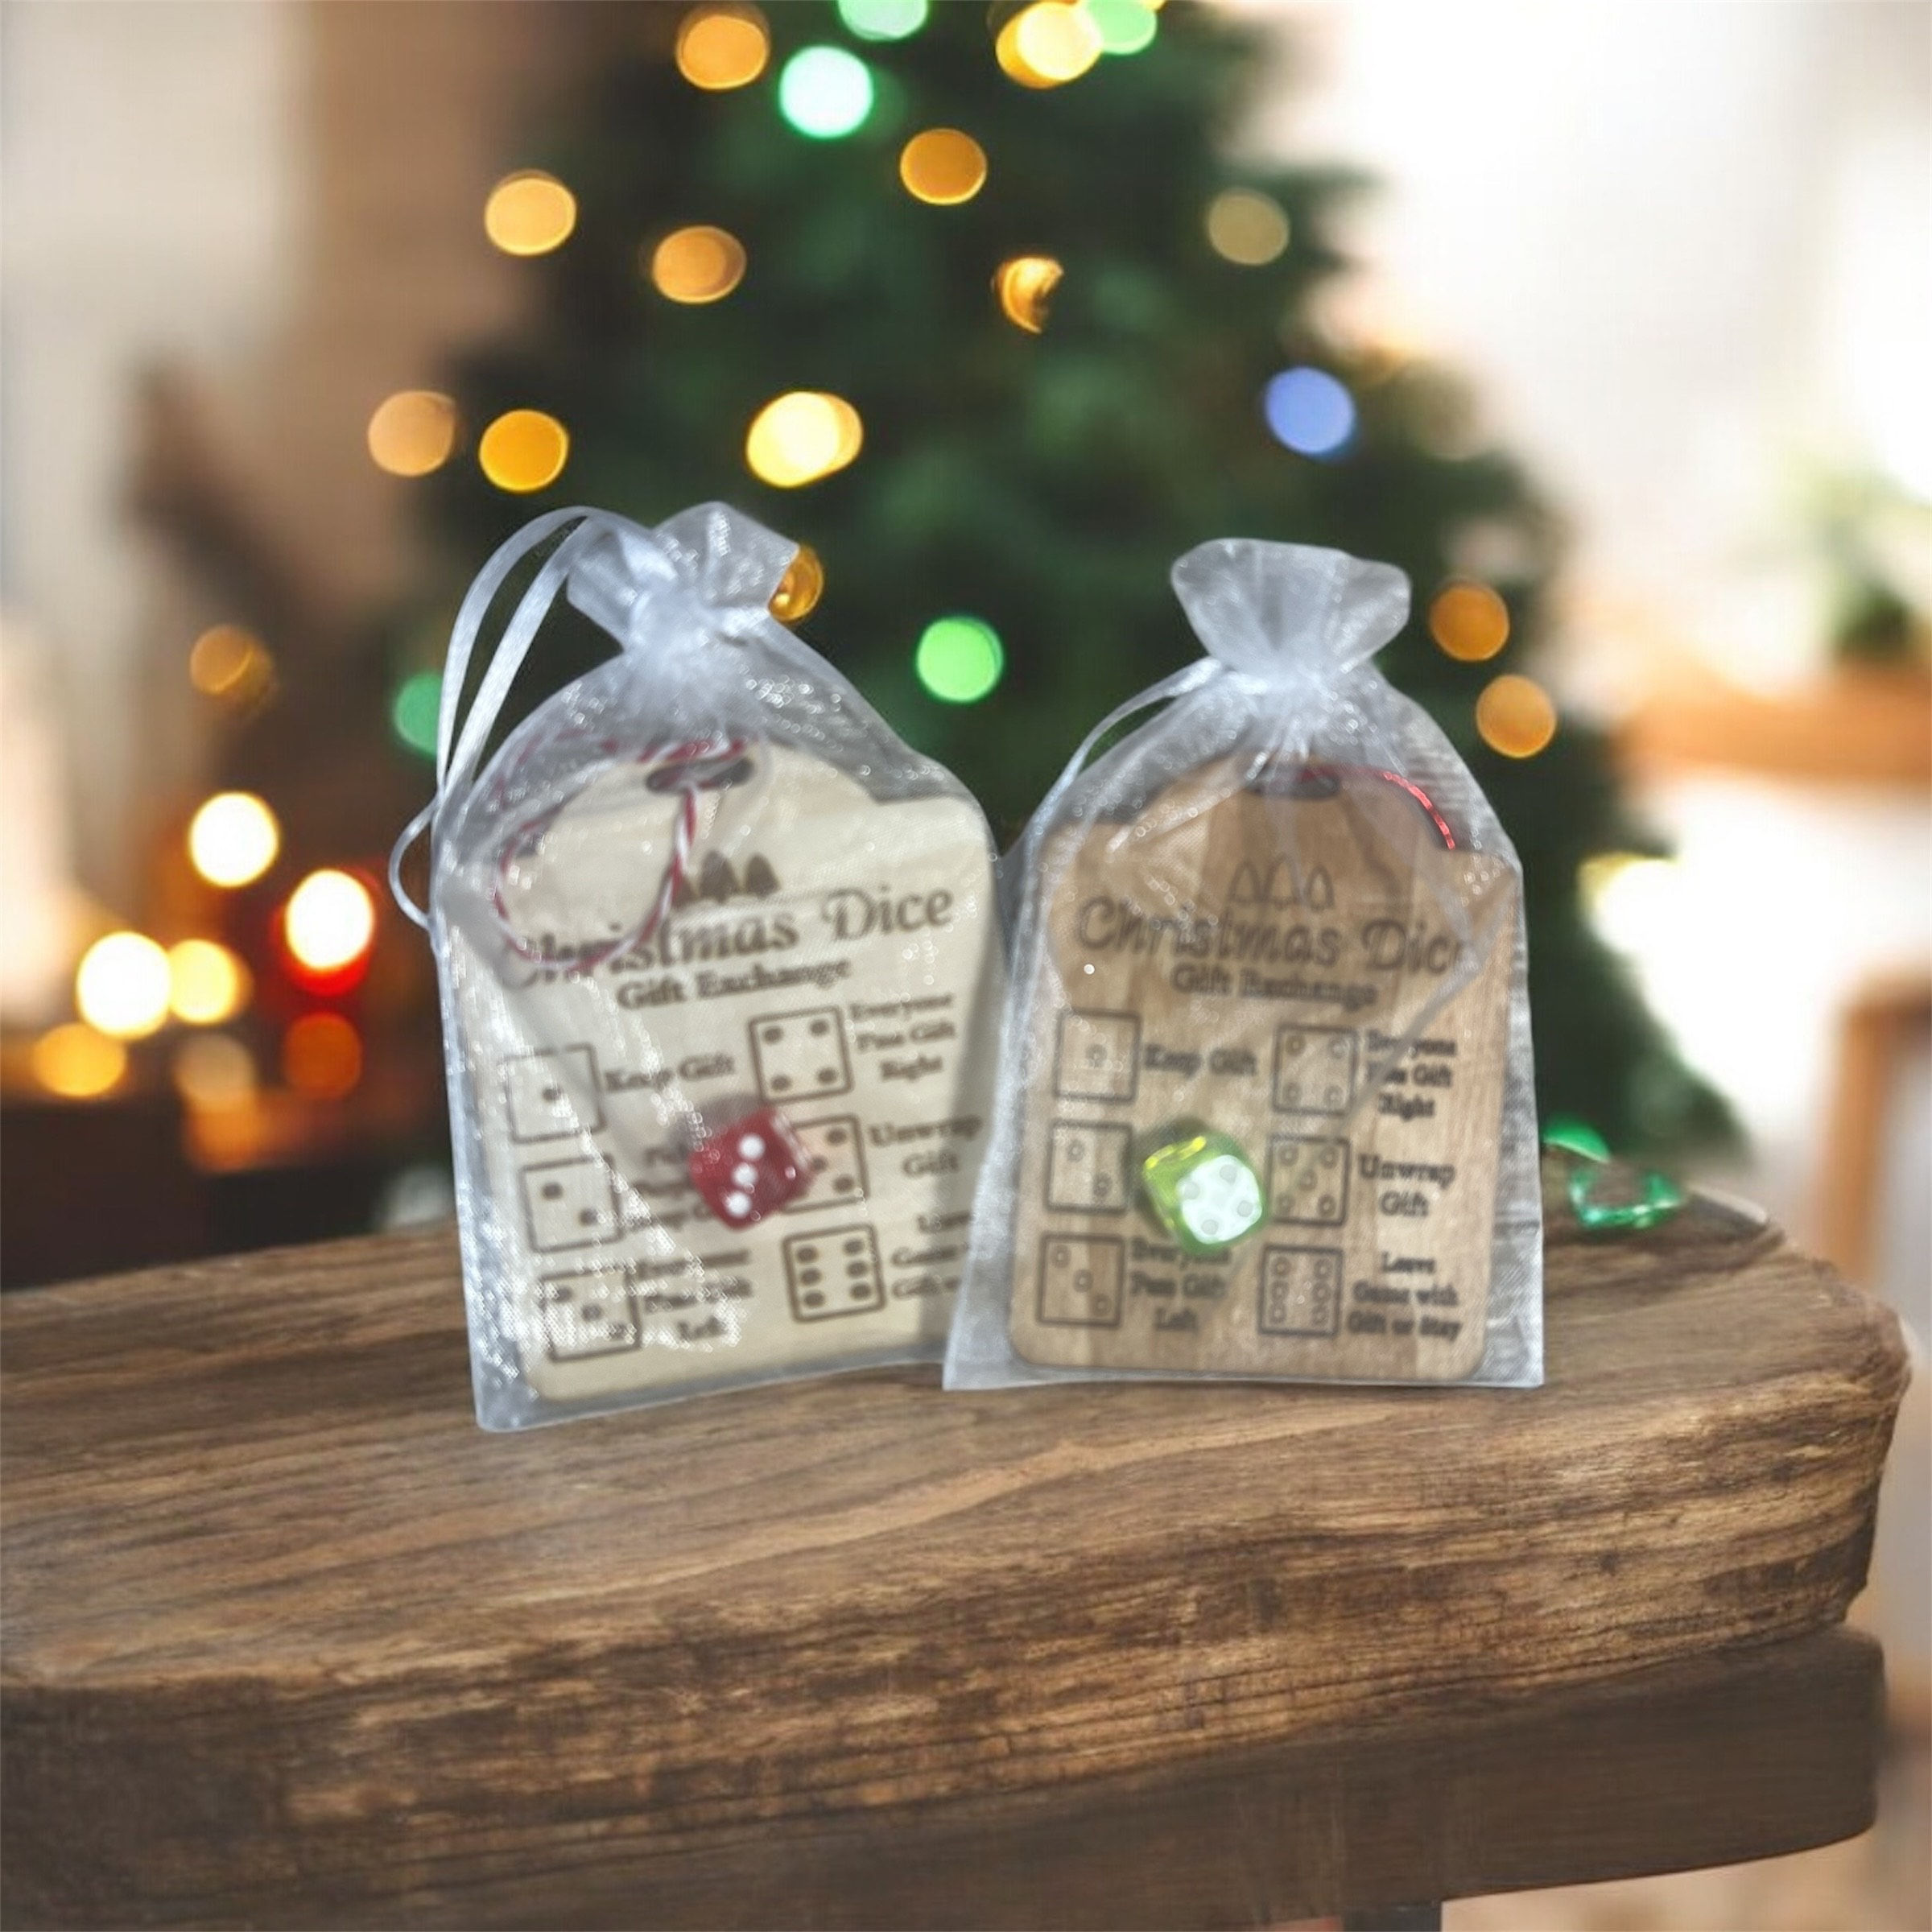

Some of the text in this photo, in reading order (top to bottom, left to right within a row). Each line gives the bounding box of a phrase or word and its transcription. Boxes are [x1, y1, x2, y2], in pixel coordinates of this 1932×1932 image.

[819, 886, 953, 942] Dice
[1077, 895, 1343, 968] Christmas
[617, 960, 850, 1009] Gift Exchange
[1171, 964, 1232, 995] Gift
[678, 1051, 734, 1081] Gift
[1412, 1063, 1453, 1088] Gift
[902, 1150, 960, 1179] Gift
[1357, 1153, 1455, 1190] Unwrap
[1380, 1190, 1428, 1216] Gift
